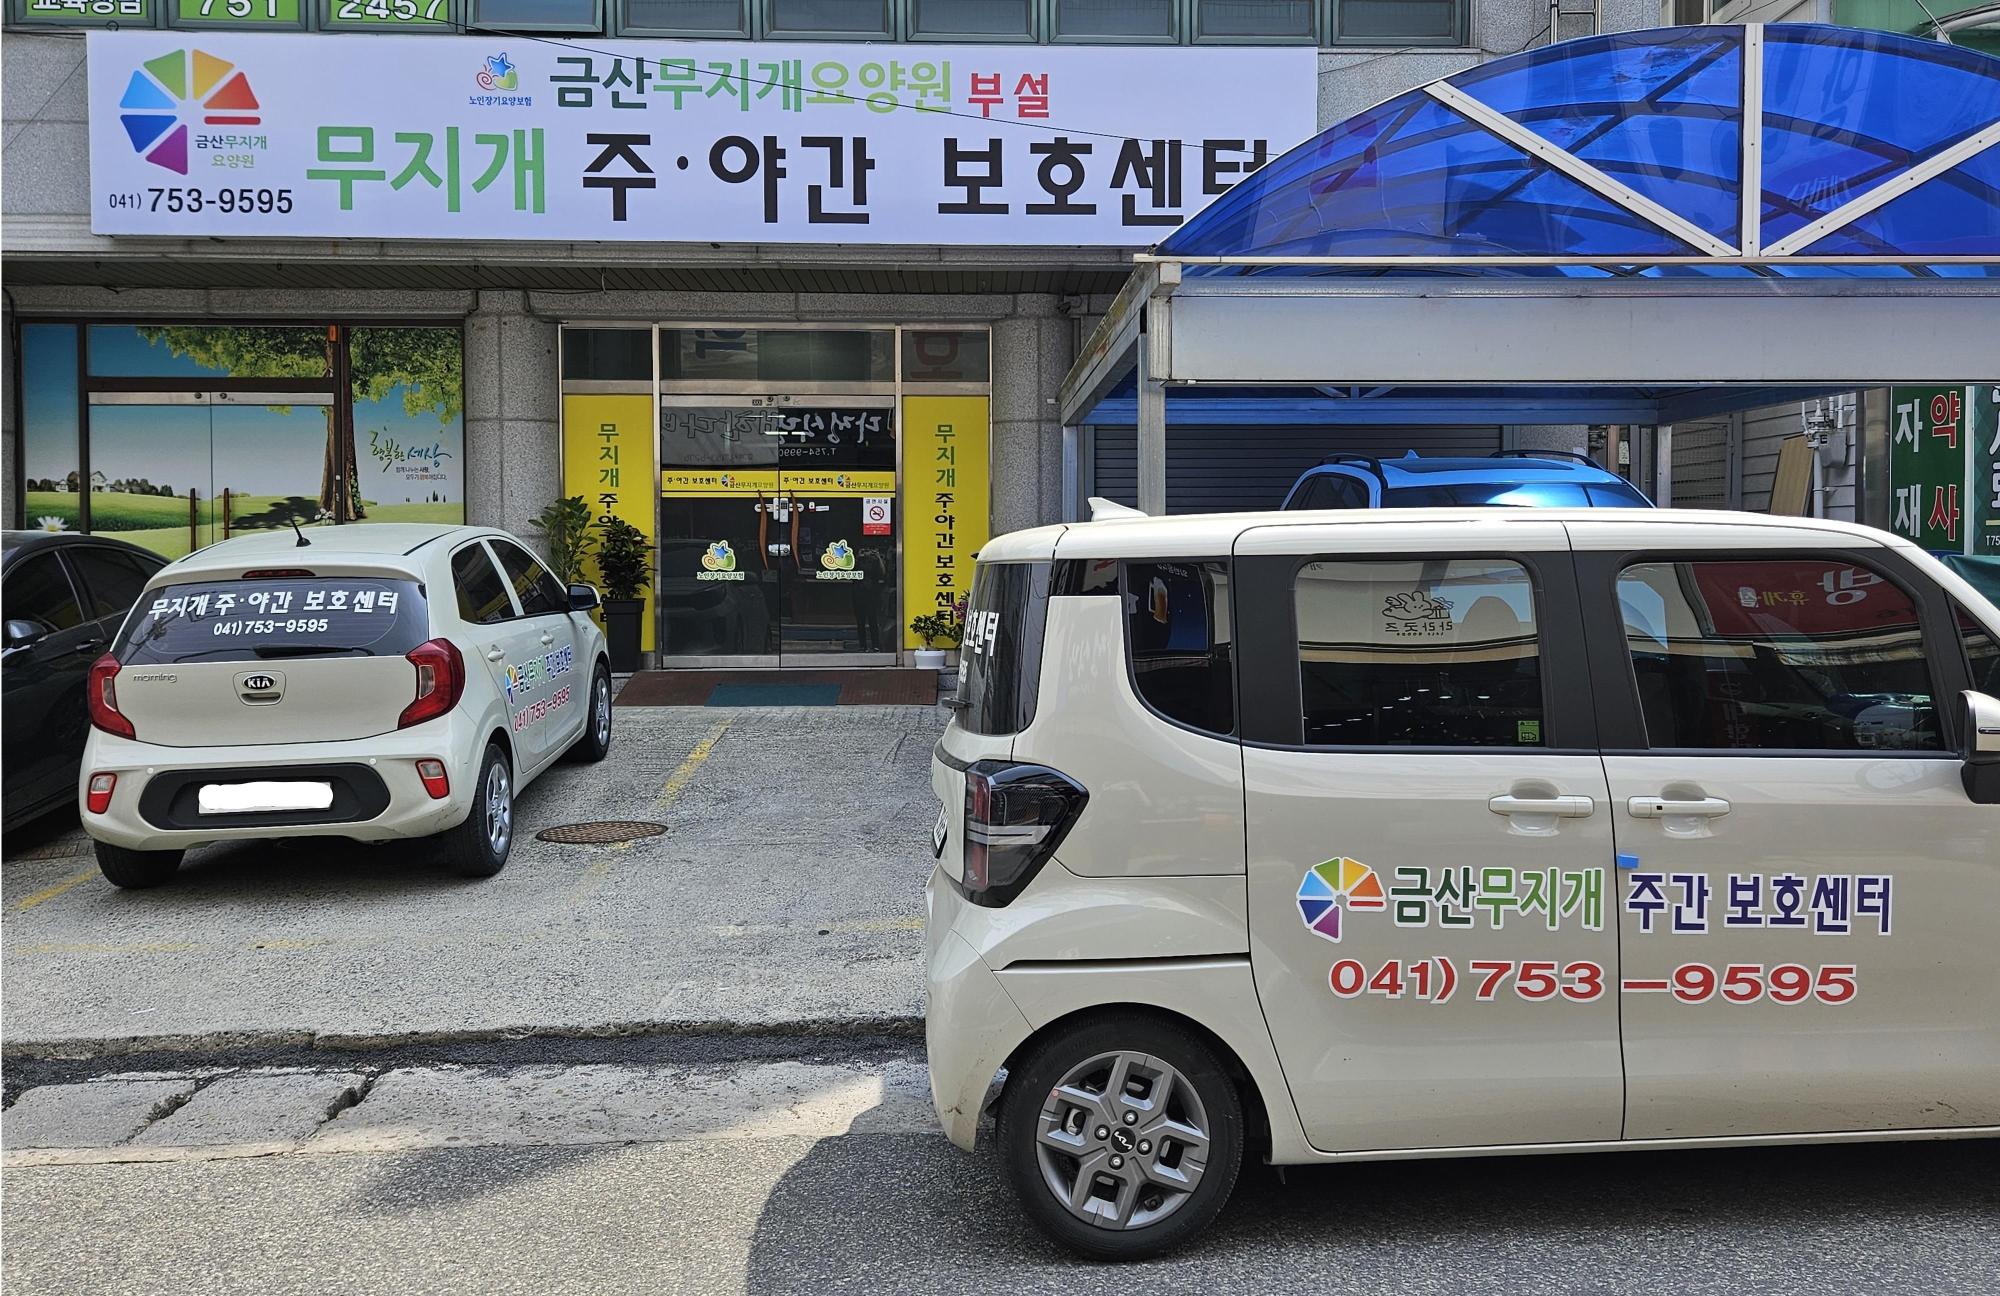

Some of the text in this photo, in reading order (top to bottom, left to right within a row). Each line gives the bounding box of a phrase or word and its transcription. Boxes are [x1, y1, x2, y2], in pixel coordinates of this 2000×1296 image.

[469, 95, 532, 107] 노인장기요양보험
[549, 55, 1051, 119] 금산무지개요양원 부설
[195, 134, 267, 150] 금산무지개
[211, 153, 255, 169] 요양원
[306, 125, 546, 214] 무지개
[582, 132, 876, 225] 주·야간
[109, 187, 294, 215] 041) 753-9595
[407, 442, 453, 468] 세상
[598, 423, 620, 488] 무지개
[934, 424, 956, 487] 무지개
[148, 594, 209, 621] 무지개
[303, 589, 399, 615] 보호센터
[213, 618, 328, 637] 041) 753-9595
[133, 672, 178, 684] morning
[247, 677, 271, 688] KIA
[1391, 866, 1892, 935] 금산무지개 주간 보호센터
[1329, 957, 1458, 1003] 041)
